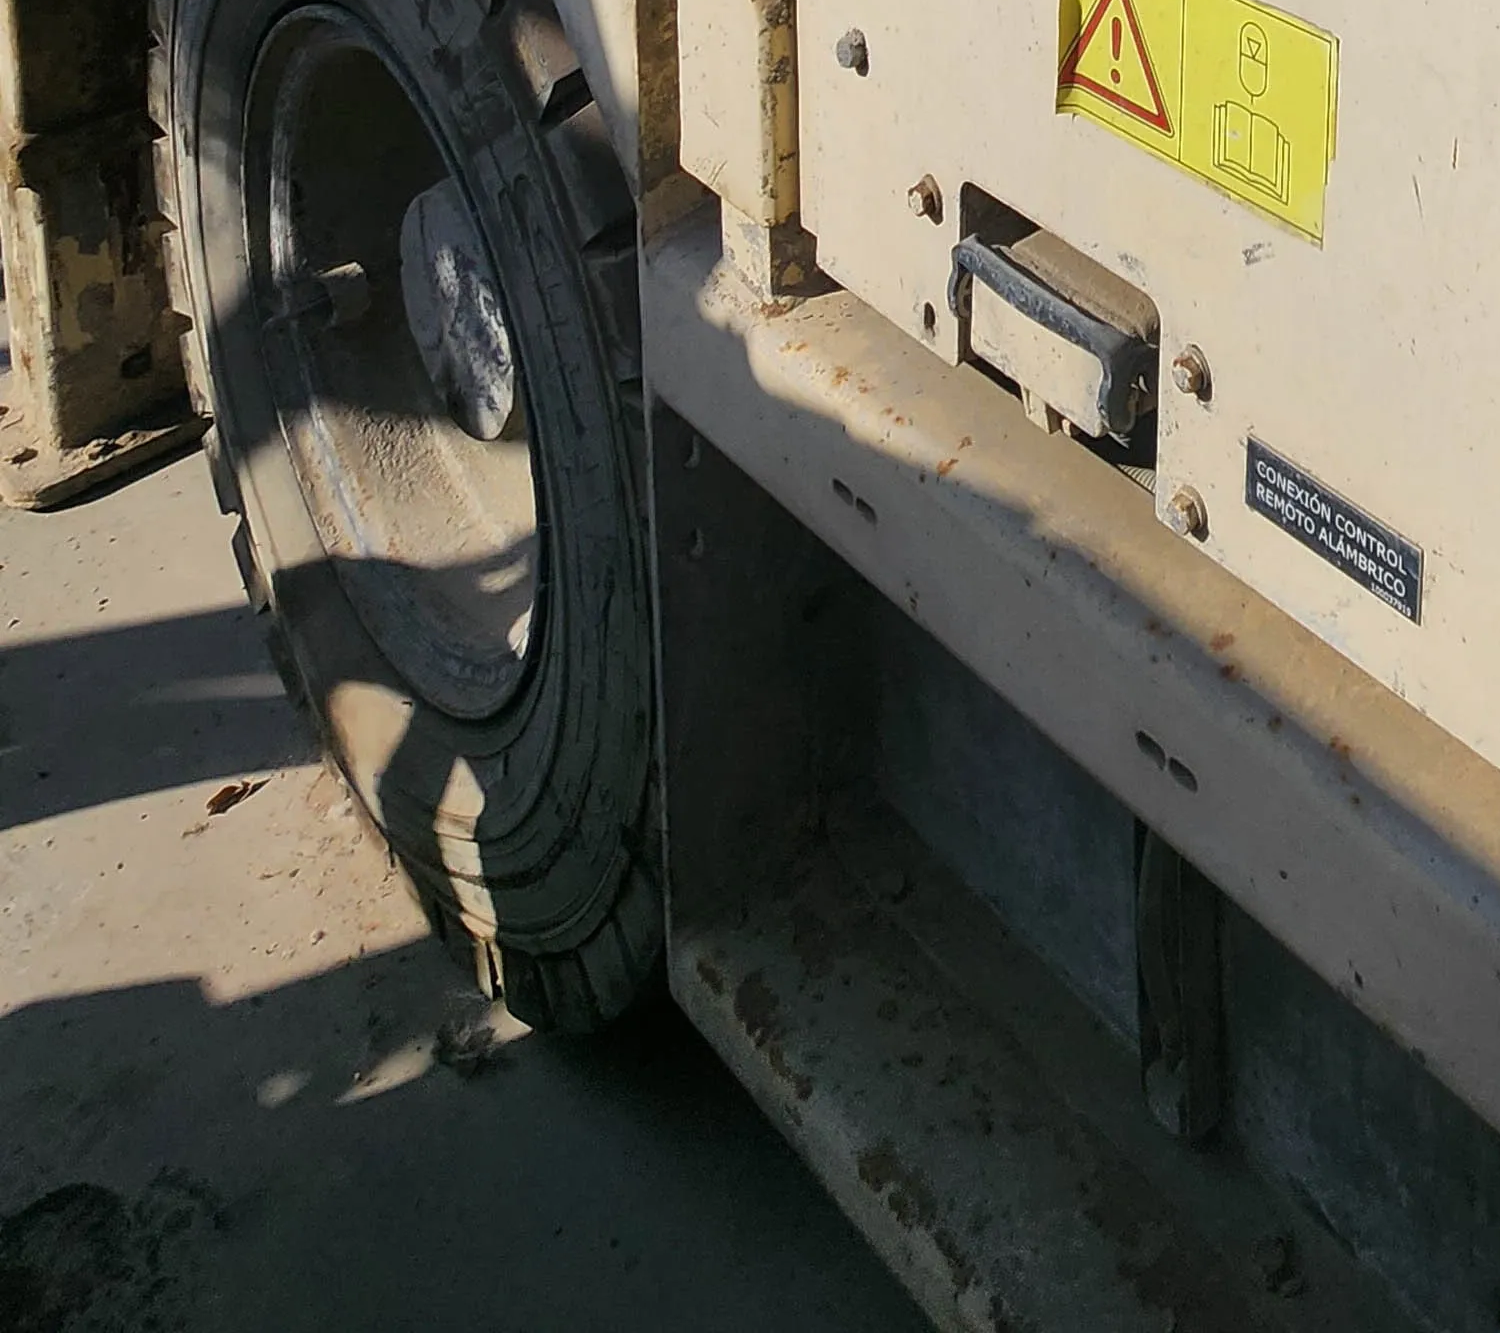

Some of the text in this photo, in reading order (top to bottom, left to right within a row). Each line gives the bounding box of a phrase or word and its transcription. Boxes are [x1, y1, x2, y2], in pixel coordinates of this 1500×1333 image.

[1256, 460, 1407, 576] CONEXIÓN CONTROL
[1256, 482, 1406, 598] REMOTO ALÁMBRICO
